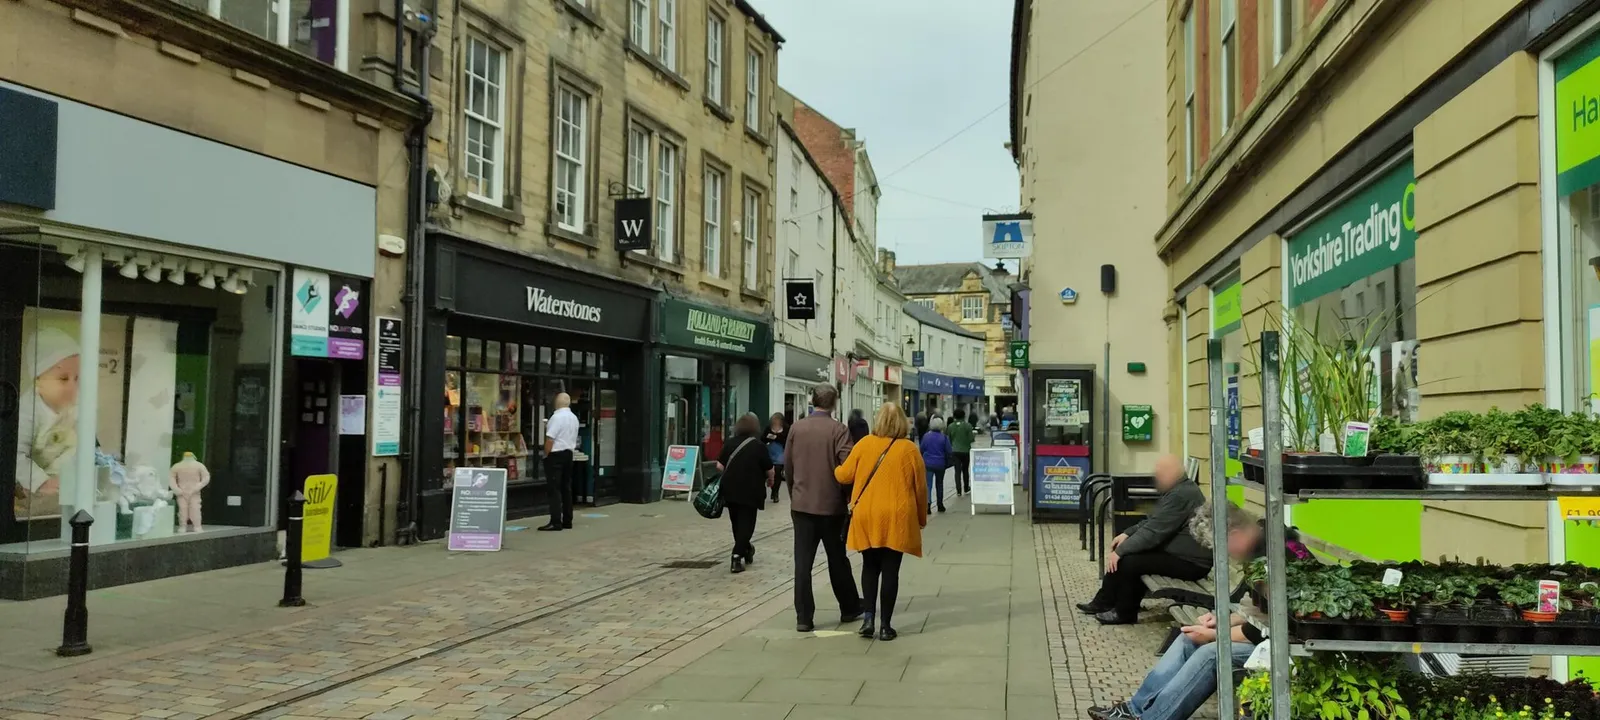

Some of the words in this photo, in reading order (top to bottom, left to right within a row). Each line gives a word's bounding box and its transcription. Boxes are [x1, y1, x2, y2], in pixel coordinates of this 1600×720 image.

[621, 219, 645, 238] W
[1291, 233, 1343, 288] Yorkshire
[1342, 201, 1401, 262] Trading
[526, 286, 602, 323] Waterstones
[687, 309, 721, 333] HOLLAND
[720, 316, 729, 338] &
[727, 318, 756, 342] BARRETT
